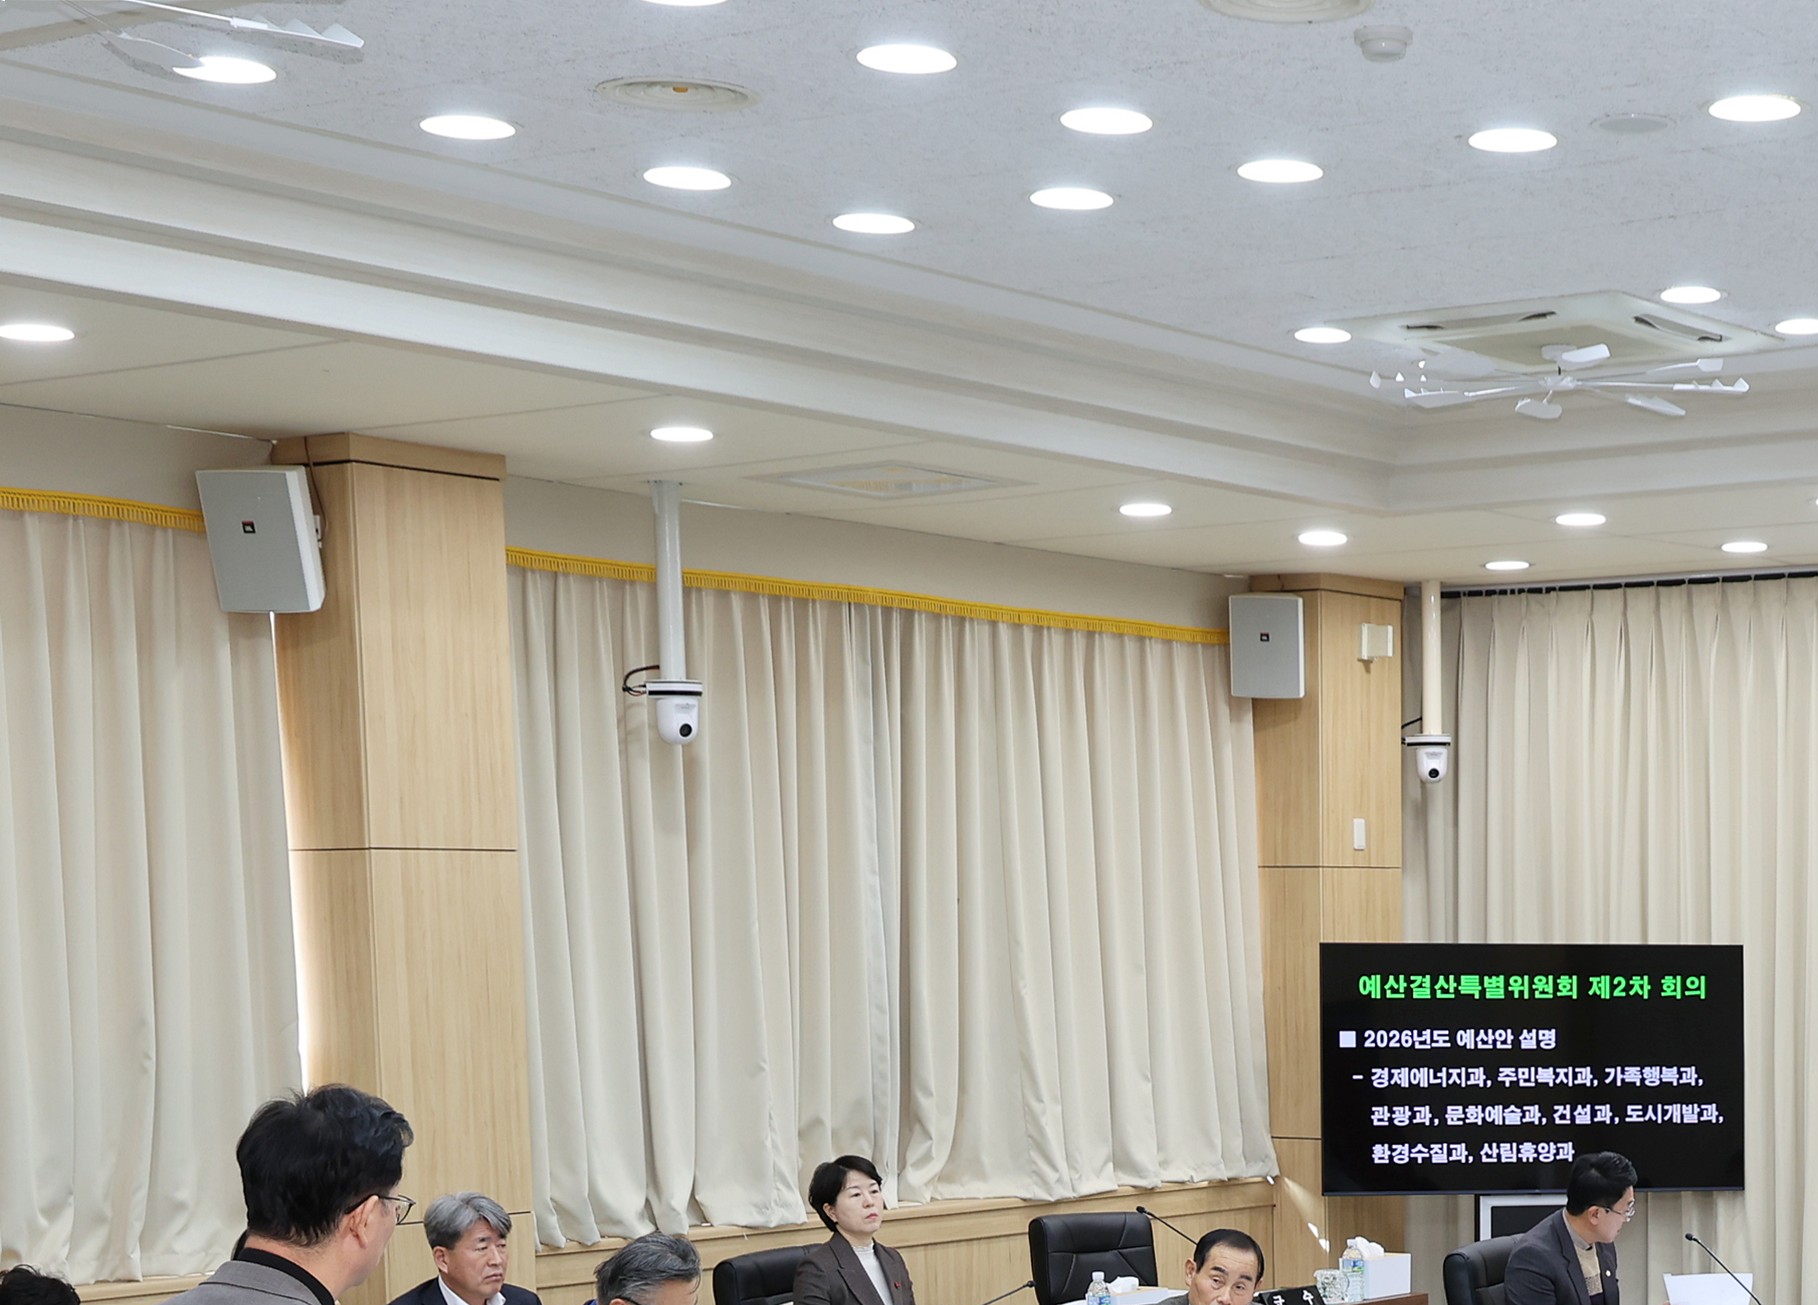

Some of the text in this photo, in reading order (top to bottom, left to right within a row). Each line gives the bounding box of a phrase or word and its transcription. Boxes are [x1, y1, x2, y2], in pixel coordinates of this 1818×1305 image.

[1358, 974, 1707, 1000] 예산결산특별위원회 제2차 회의
[1363, 1028, 1557, 1050] 2026년도 예산안 설명
[1370, 1066, 1493, 1089] 경제에너지과,
[1497, 1066, 1599, 1088] 주민복지과,
[1604, 1065, 1704, 1087] 가족행복과,
[1370, 1103, 1725, 1127] 관광과, 문화예술과, 건설과, 도시개발과,
[1371, 1141, 1575, 1165] 환경수질과, 산림휴양과
